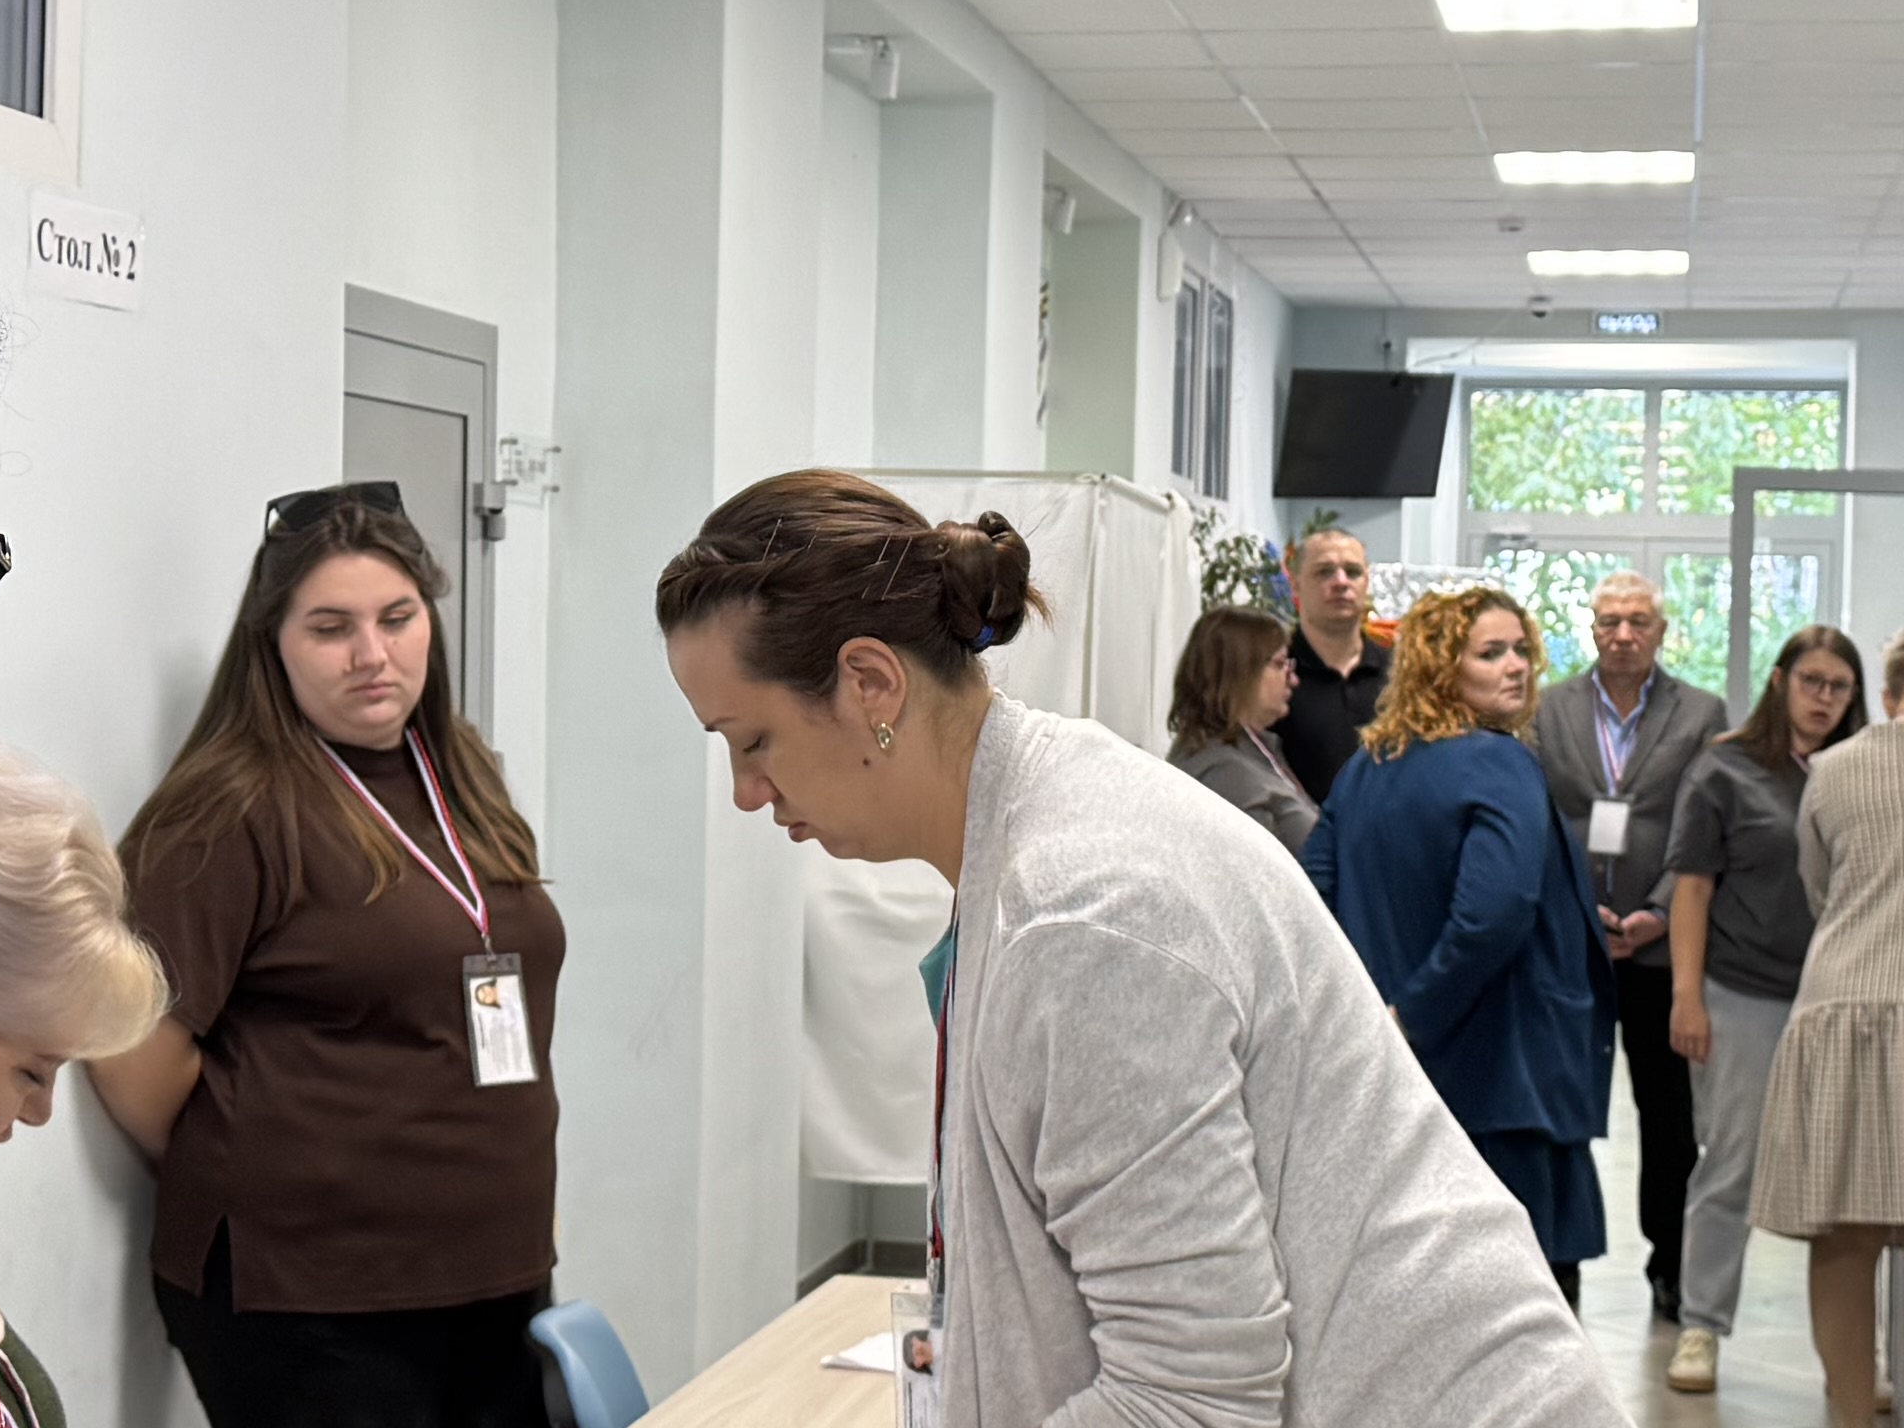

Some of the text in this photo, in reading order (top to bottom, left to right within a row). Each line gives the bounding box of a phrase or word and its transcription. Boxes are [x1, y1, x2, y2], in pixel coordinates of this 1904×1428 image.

[37, 218, 136, 280] Стол № 2
